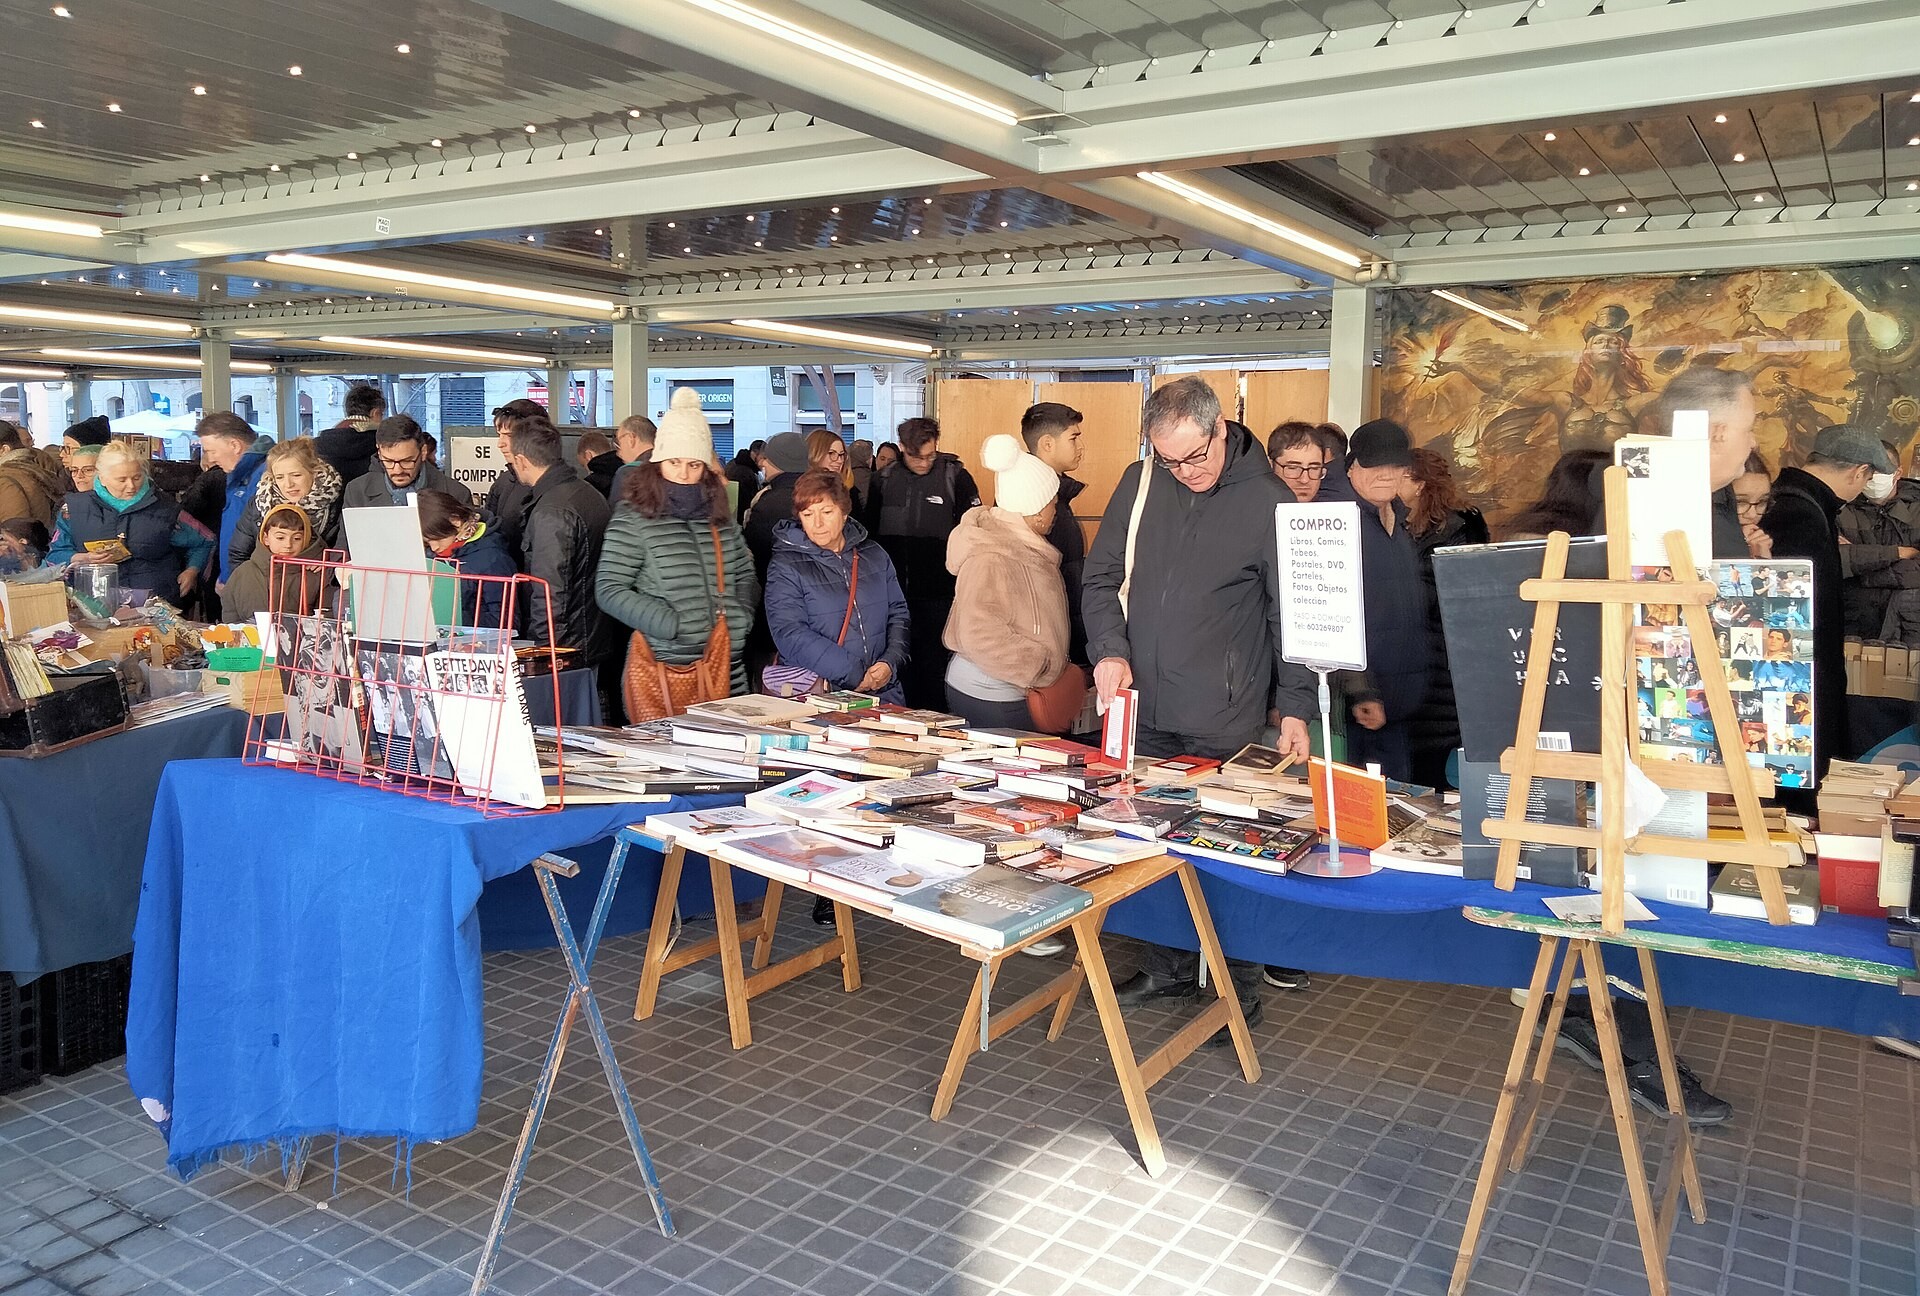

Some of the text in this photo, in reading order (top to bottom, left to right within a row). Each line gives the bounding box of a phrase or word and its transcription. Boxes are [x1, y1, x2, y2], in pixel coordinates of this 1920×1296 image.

[707, 393, 733, 403] ORIGEN
[475, 446, 491, 459] SE
[454, 469, 504, 482] COMPR
[1290, 518, 1347, 531] COMPRO:
[1317, 584, 1348, 594] Objetos
[1306, 623, 1344, 633] 603269807
[433, 657, 505, 674] BETTE DAVIS
[934, 883, 1040, 916] HOMBRES
[982, 890, 998, 898] EN
[1010, 898, 1046, 910] SANOS
[1056, 906, 1074, 918] HOMBRES
[1042, 914, 1056, 925] SANOS
[1018, 925, 1033, 937] FORMA
